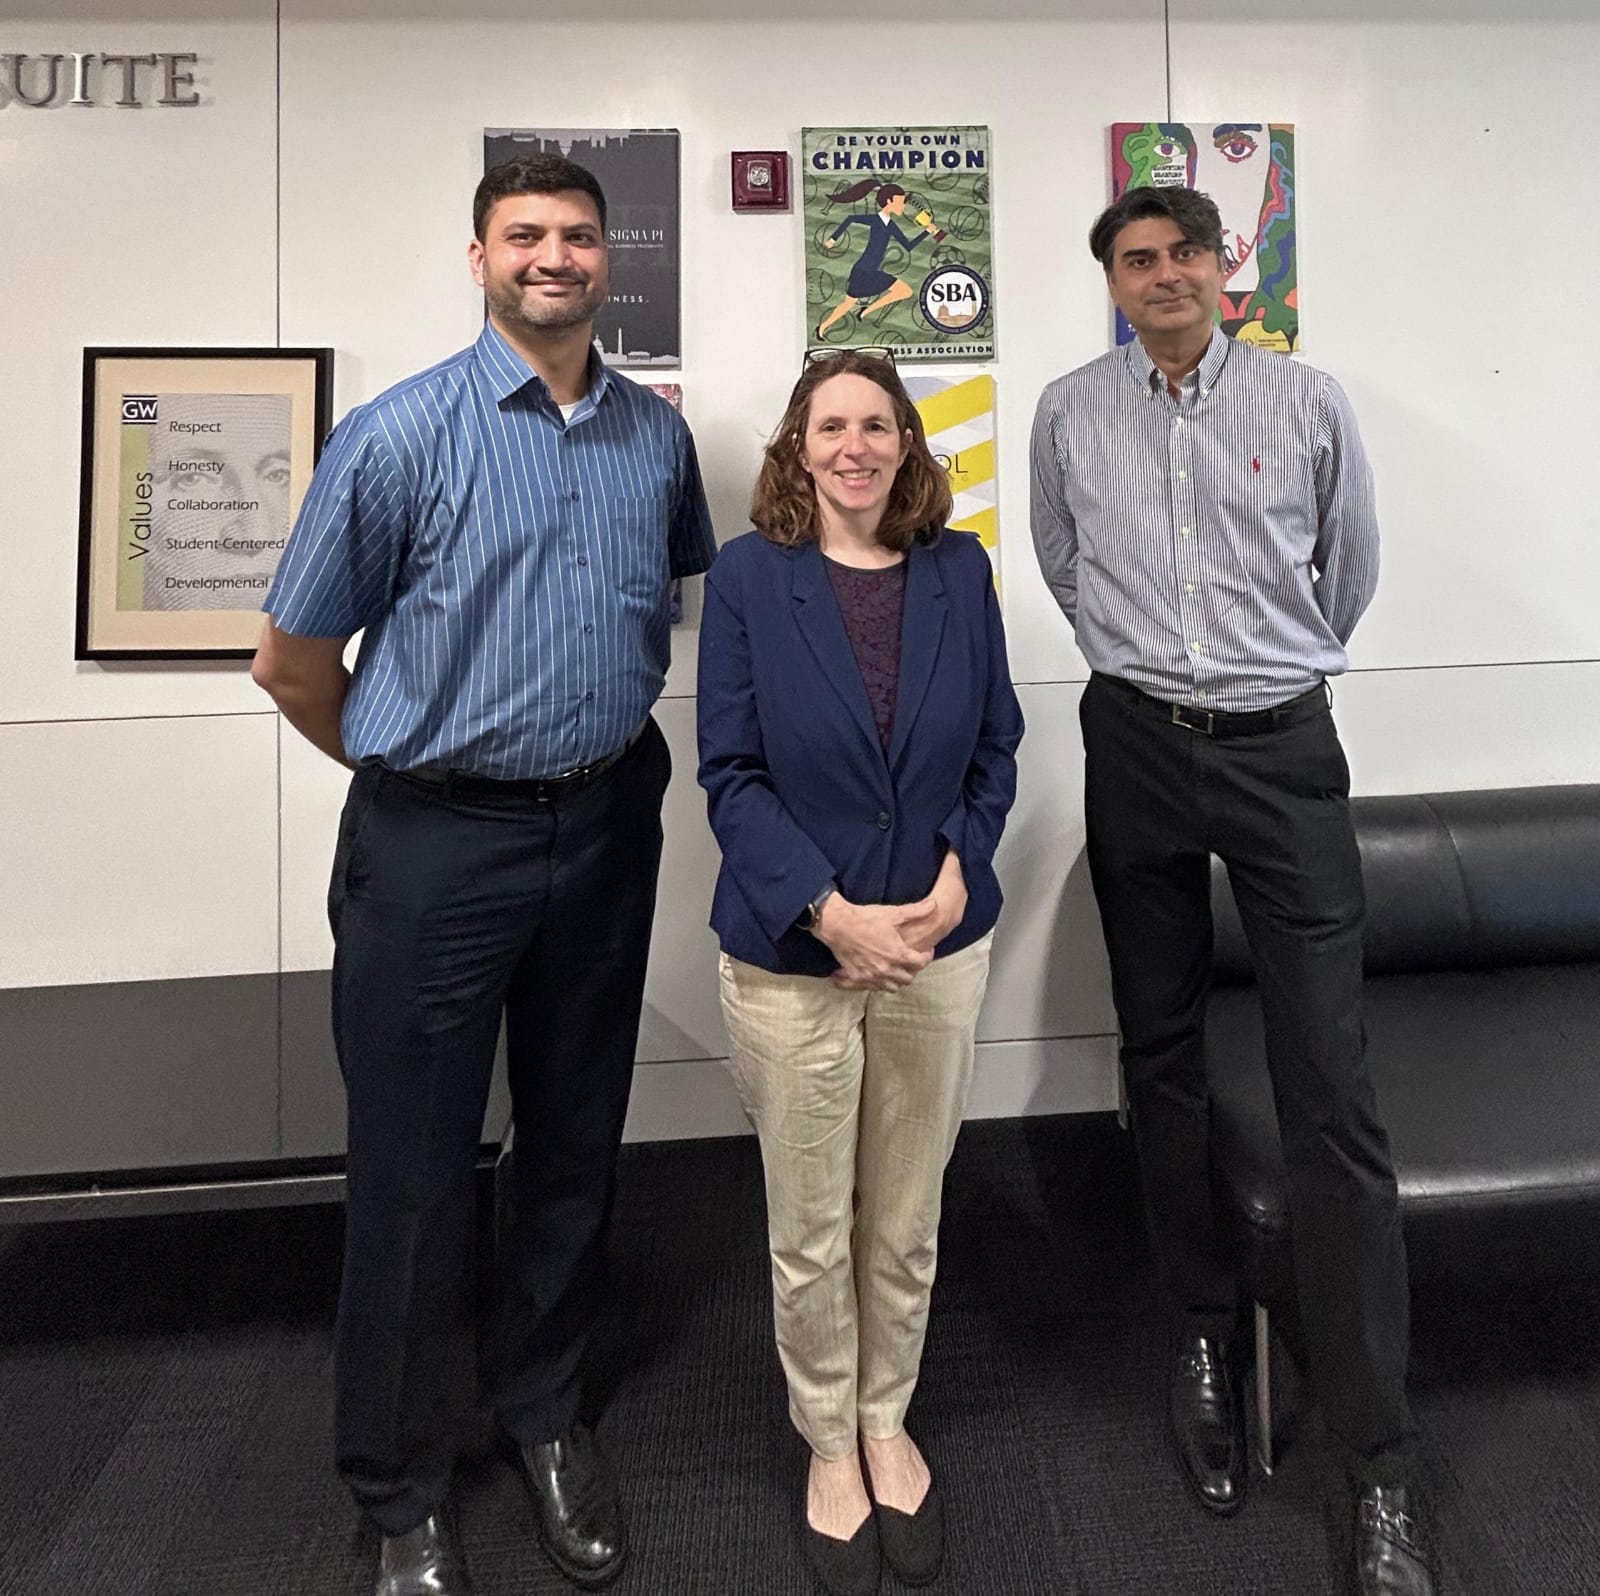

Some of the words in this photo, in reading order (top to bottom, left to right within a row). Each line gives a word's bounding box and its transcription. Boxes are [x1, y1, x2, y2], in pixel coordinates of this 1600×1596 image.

[1, 52, 200, 107] UITE
[837, 135, 857, 146] BE
[865, 135, 913, 146] YOUR
[920, 134, 960, 146] OWN
[812, 150, 985, 170] CHAMPION
[609, 229, 647, 241] SIGMA
[652, 229, 664, 241] PI
[931, 283, 977, 302] SBA
[917, 346, 993, 354] ASSOCIATION
[122, 401, 157, 418] GW
[169, 421, 222, 435] Respect
[168, 460, 225, 474] Honesty
[167, 499, 259, 511] Collaboration
[128, 472, 154, 560] Values
[166, 537, 285, 550] Student-Centered
[165, 577, 269, 591] Developmental
